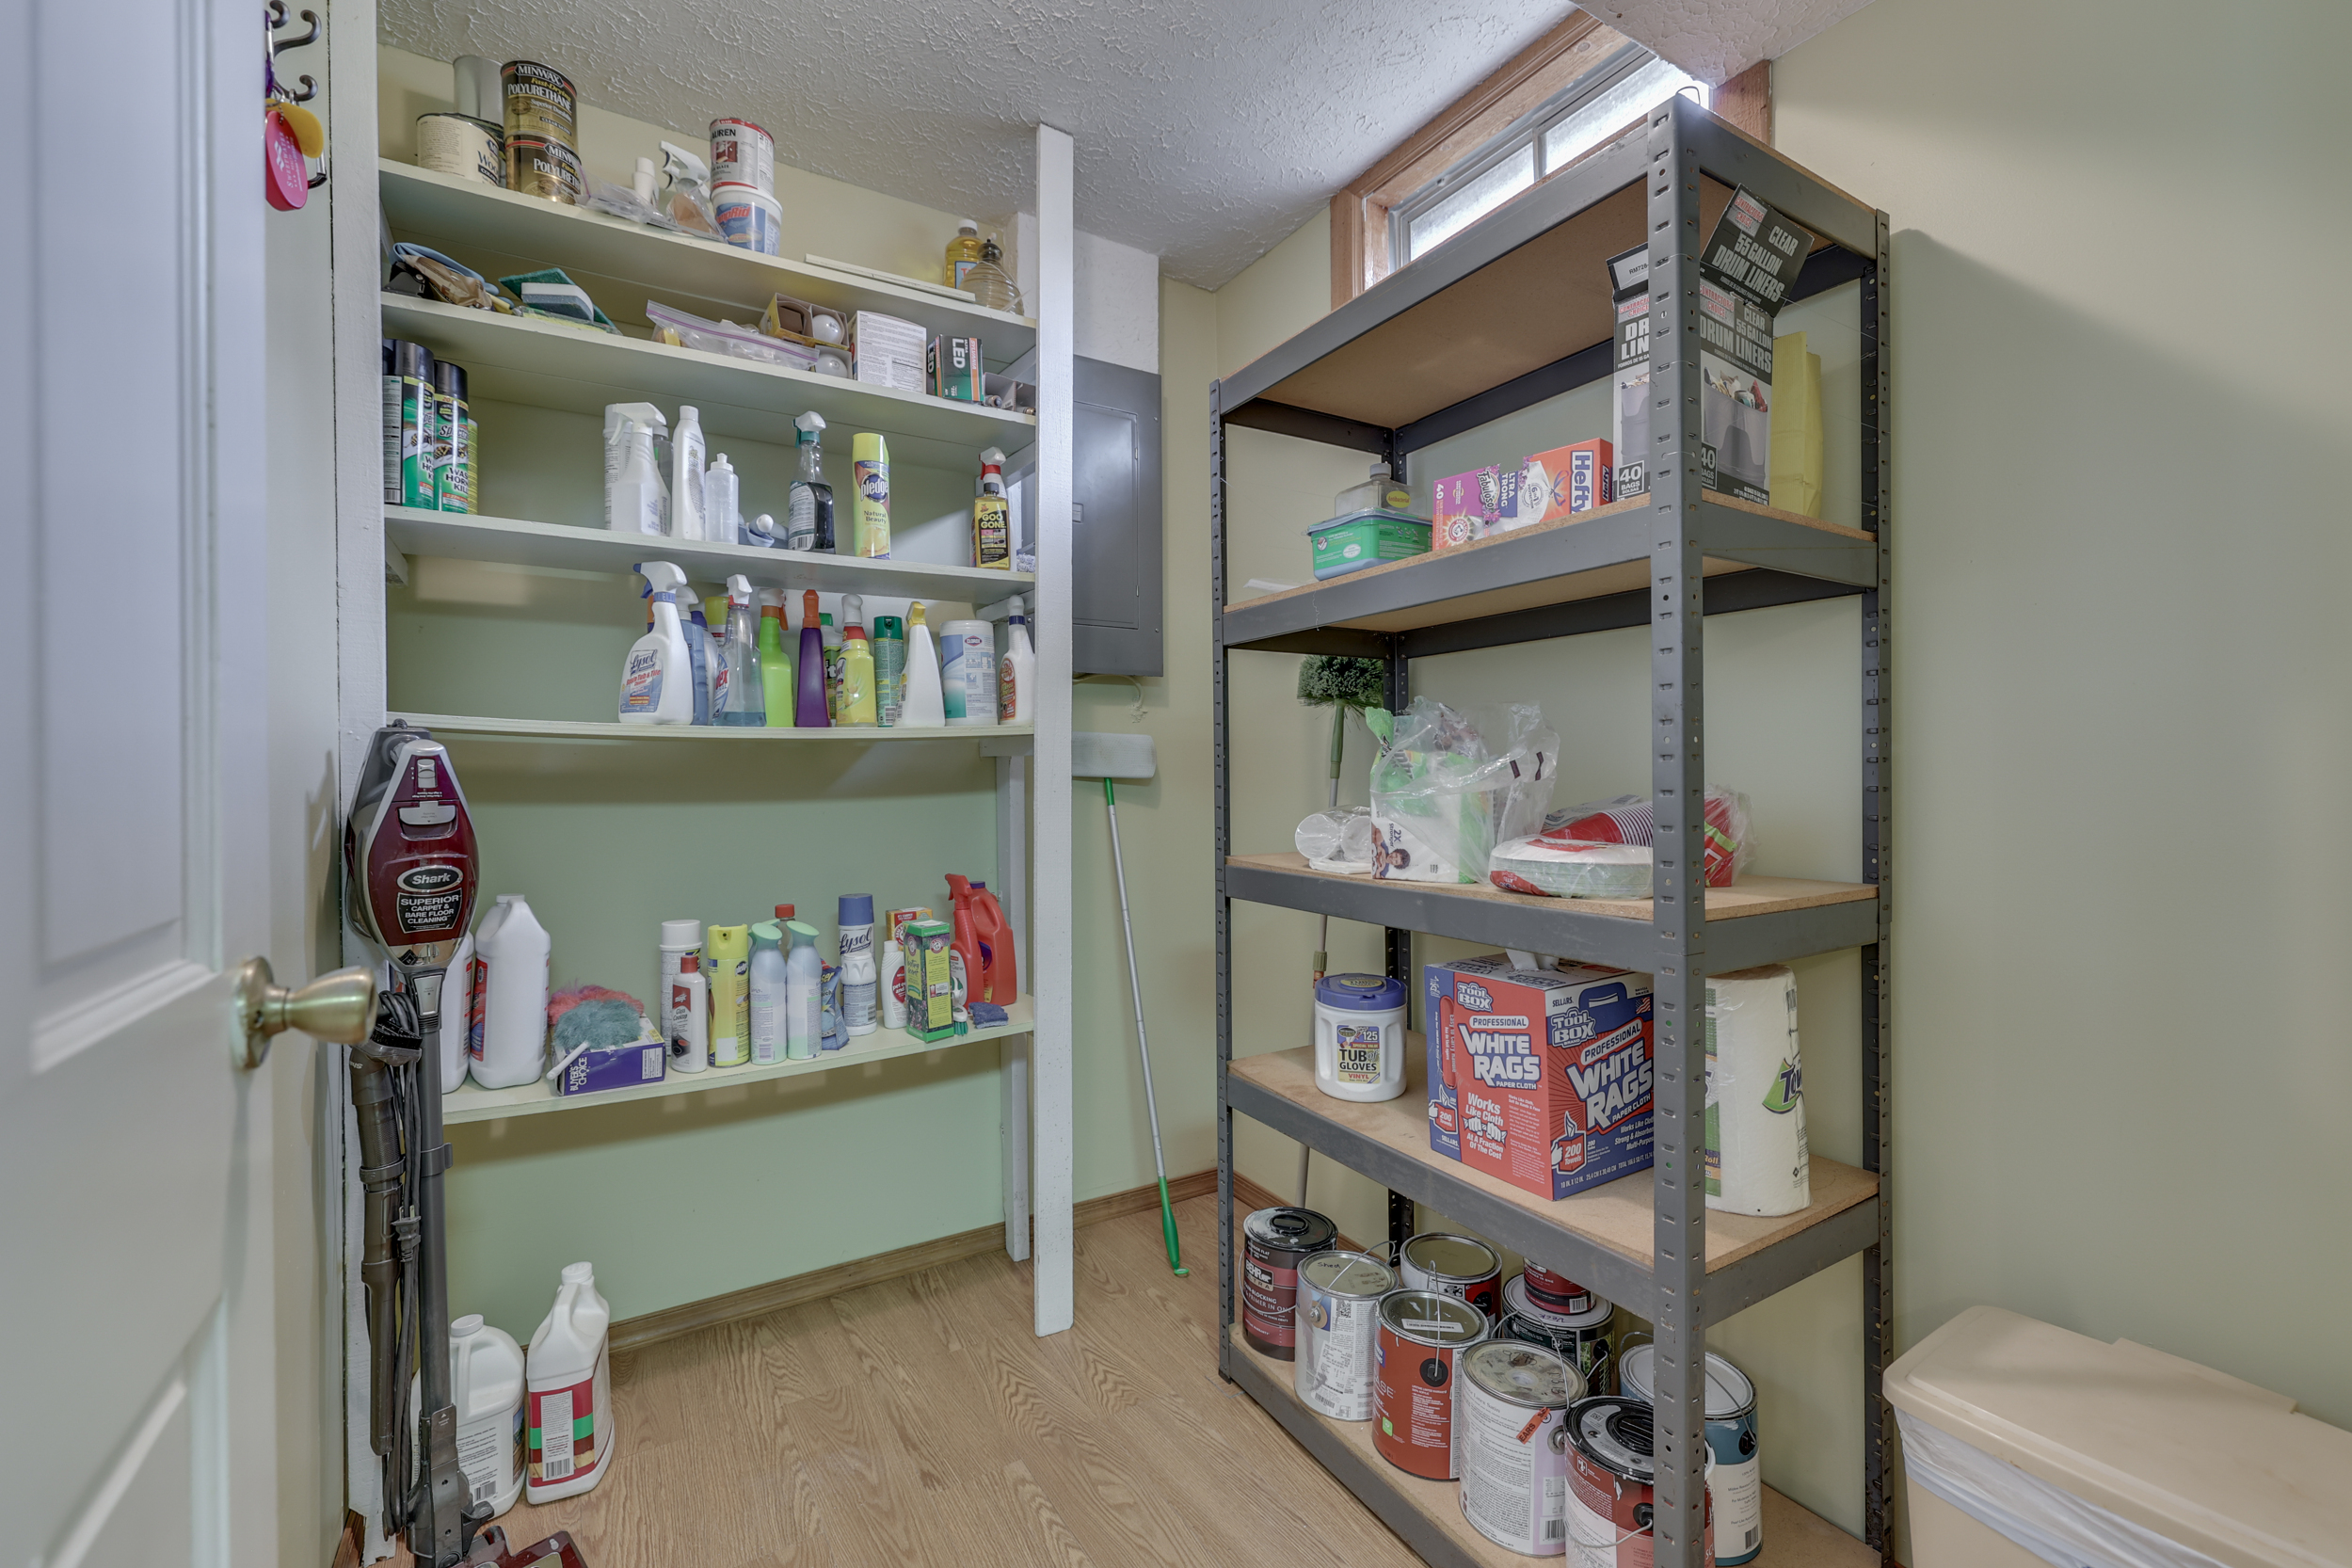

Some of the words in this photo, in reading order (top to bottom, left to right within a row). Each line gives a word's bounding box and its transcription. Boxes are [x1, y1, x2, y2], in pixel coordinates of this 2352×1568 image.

[518, 65, 561, 86] MINWAX
[508, 84, 572, 114] POLYURETHANE
[1768, 226, 1799, 257] CLEAR
[1735, 232, 1752, 256] 55
[1748, 242, 1784, 277] GALLON
[1712, 245, 1751, 282] DRUM
[1744, 265, 1785, 302] LINERS
[1744, 307, 1766, 331] CLEAR
[1700, 314, 1734, 354] DRUM
[1736, 334, 1771, 374] LINERS
[1736, 318, 1746, 336] 55
[1747, 325, 1771, 351] GALLON
[927, 344, 936, 374] LED
[952, 338, 966, 369] LED
[1620, 466, 1642, 483] 40
[860, 477, 888, 502] pledge
[1436, 484, 1444, 500] 40
[1477, 471, 1494, 509] Fabuloso
[1621, 481, 1640, 490] BAGS
[1388, 495, 1410, 504] Antibacterial
[864, 510, 887, 519] Natural
[630, 649, 658, 671] Lysol
[1394, 829, 1401, 842] 2X
[412, 873, 451, 884] Shark
[400, 895, 459, 905] SUPERIOR
[408, 916, 447, 924] CLEANING
[840, 926, 872, 954] Lysol
[1458, 983, 1489, 998] TOOL
[1459, 993, 1492, 1010] BOX
[1552, 997, 1573, 1008] SELLARS
[1472, 1017, 1527, 1027] PROFESSIONAL
[1553, 1013, 1592, 1029] TOOL
[1363, 1032, 1378, 1041] 125
[1458, 1025, 1530, 1055] WHITE
[1554, 1021, 1594, 1044] BOX
[1585, 1023, 1640, 1063] PROFESSIONAL
[1339, 1048, 1367, 1063] TUB
[579, 1056, 587, 1085] CHOICE
[1339, 1062, 1377, 1071] GLOVES
[1474, 1055, 1540, 1086] RAGS
[1566, 1039, 1645, 1099] WHITE
[1468, 1093, 1501, 1114] Works
[1587, 1060, 1653, 1128] RAGS
[1439, 1111, 1452, 1122] 200
[1465, 1105, 1481, 1118] Like
[1482, 1112, 1504, 1127] Cloth
[1612, 1106, 1632, 1123] PAPER
[1633, 1094, 1651, 1111] CLOTH
[1621, 1124, 1634, 1134] Works
[1479, 1137, 1504, 1153] Fraction
[1615, 1135, 1629, 1145] Strong
[1478, 1144, 1487, 1154] The
[1488, 1149, 1502, 1160] Cost
[1565, 1143, 1582, 1158] 200
[1564, 1155, 1582, 1166] Towels
